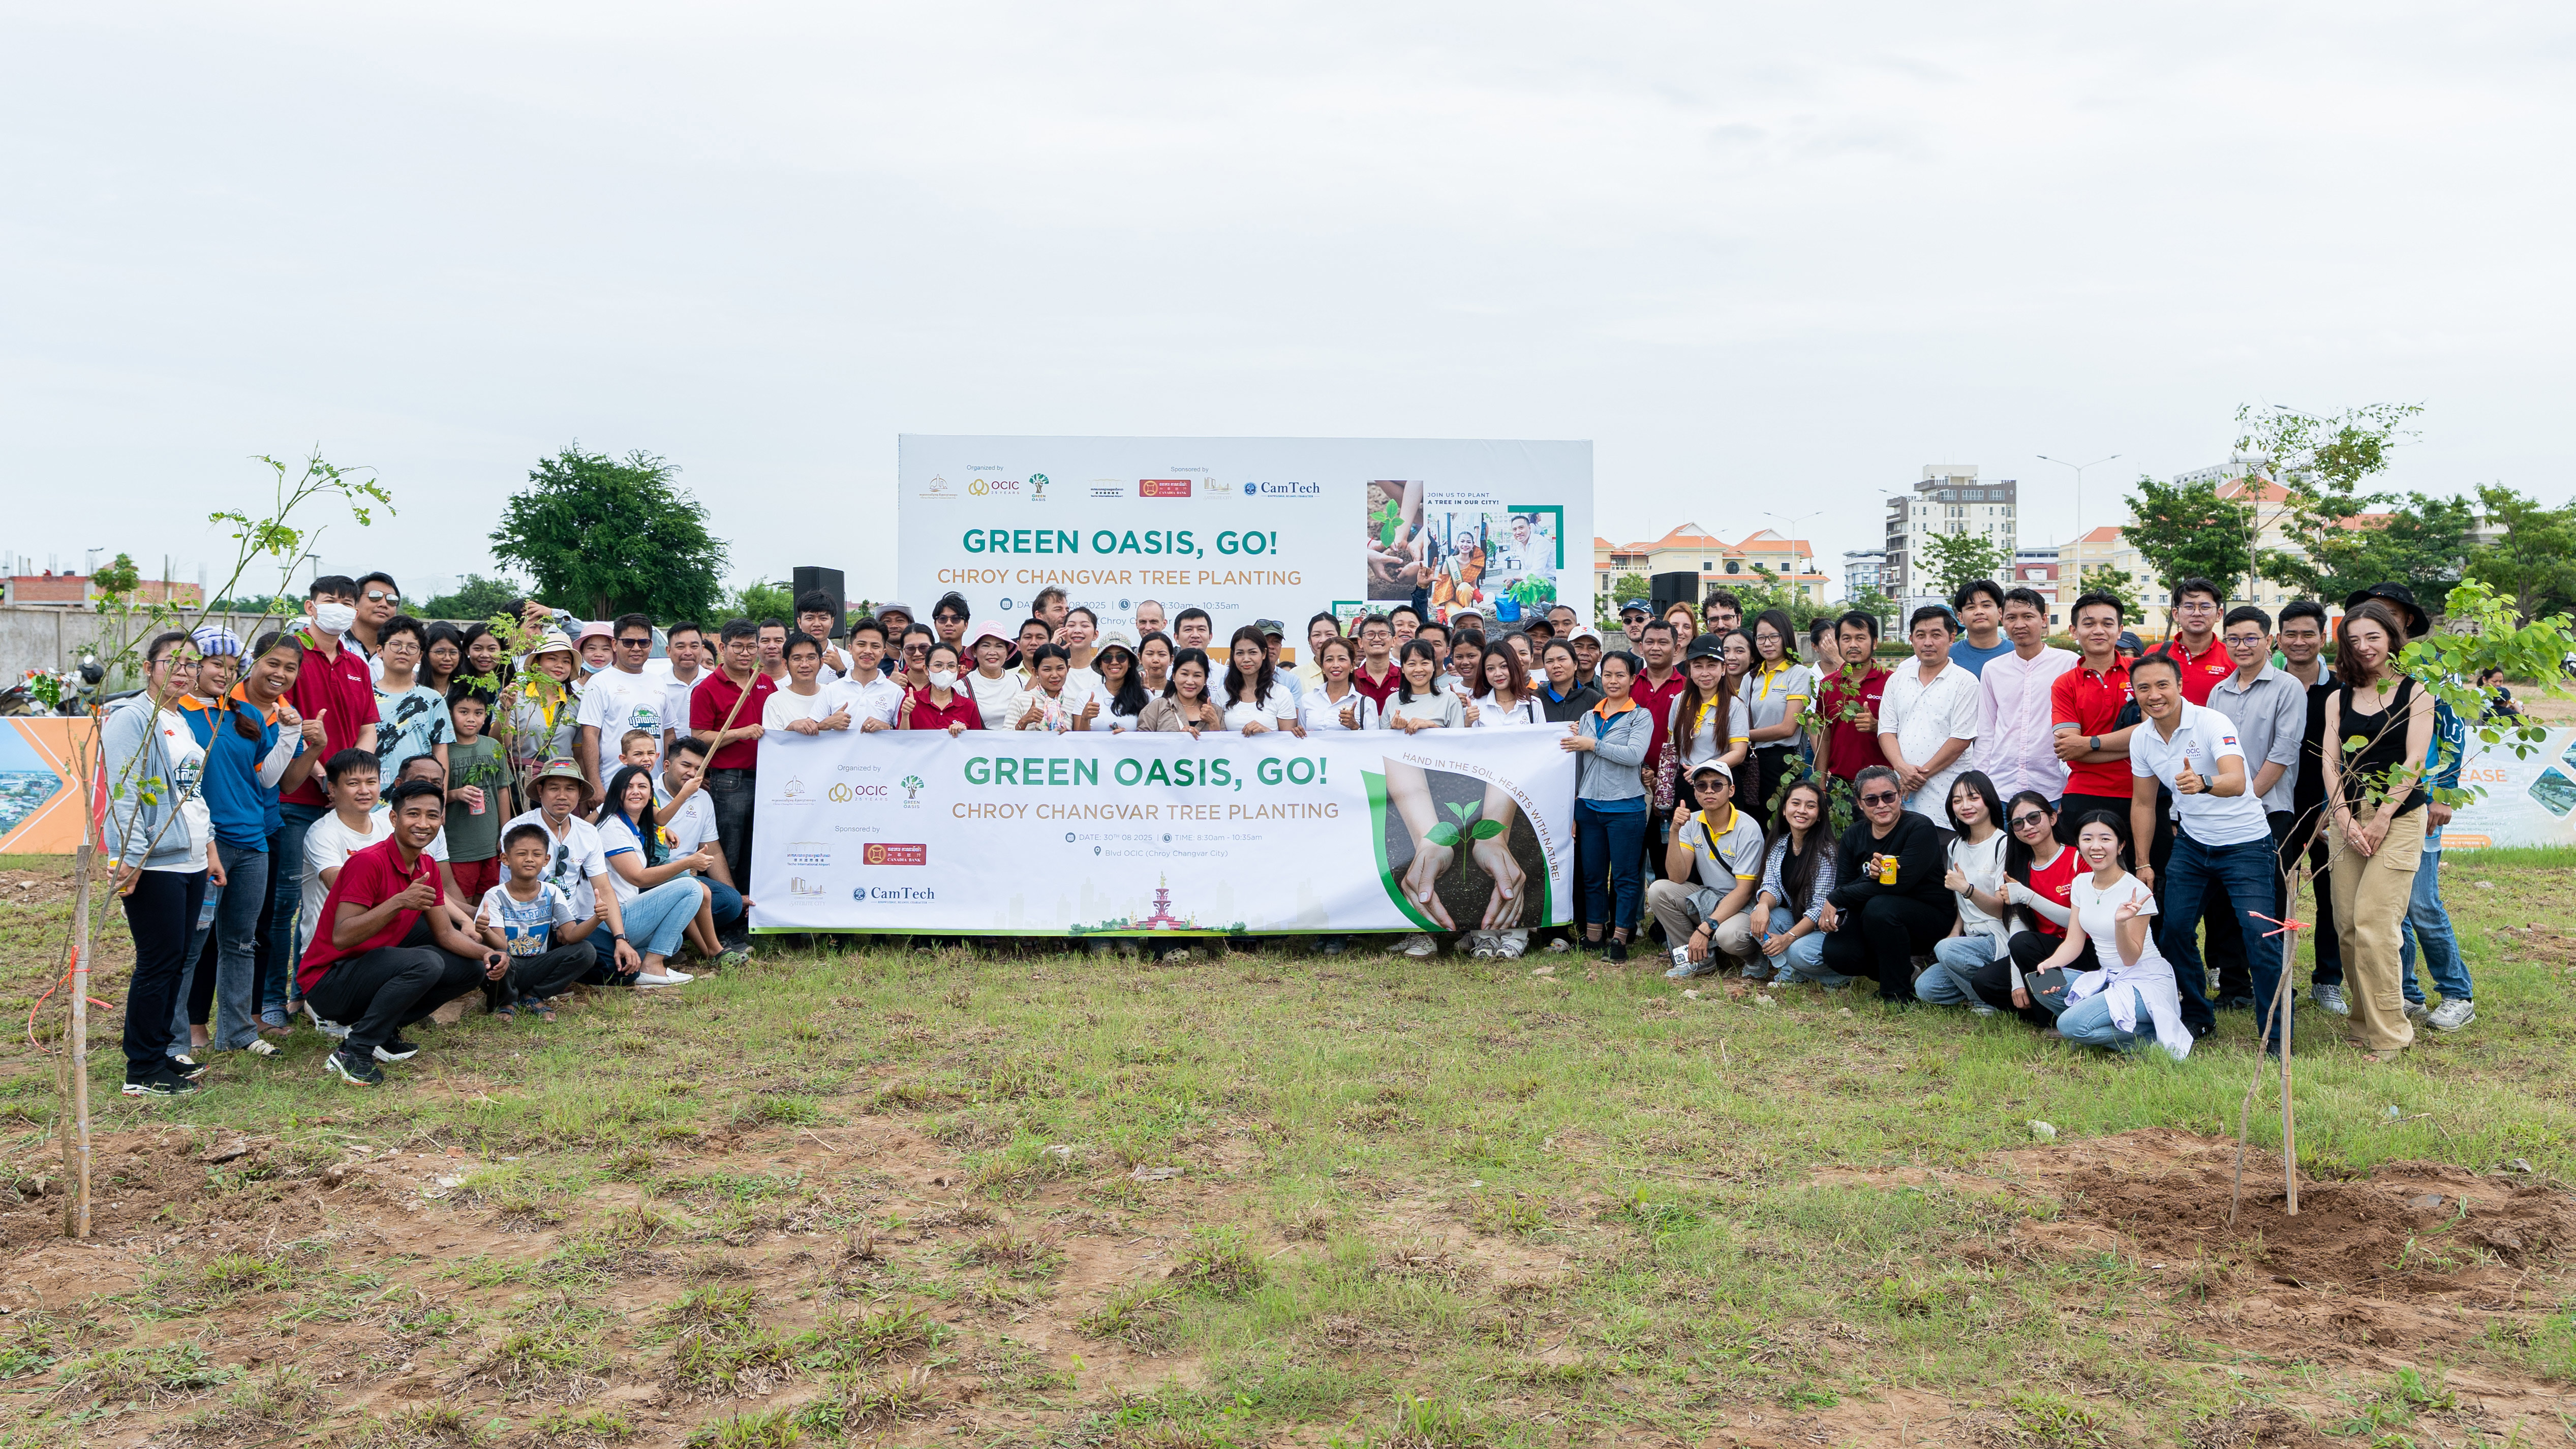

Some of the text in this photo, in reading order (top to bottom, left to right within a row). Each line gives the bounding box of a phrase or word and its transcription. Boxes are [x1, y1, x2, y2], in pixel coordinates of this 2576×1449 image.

[992, 481, 1019, 489] OCIC
[1261, 482, 1320, 493] CamTech
[963, 529, 1276, 559] GREEN OASIS, GO!
[938, 569, 1301, 585] CHROY CHANGVAR TREE PLANTING
[1097, 617, 1126, 626] (Chroy
[450, 755, 481, 768] FLEXING
[964, 757, 1327, 791] GREEN OASIS, GO!
[855, 786, 887, 795] OCIC
[953, 803, 1338, 820] CHROY CHANGVAR TREE PLANTING
[1402, 752, 1560, 882] HAND IN THE SOIL, HEARTS WITH NATURE!
[871, 887, 934, 899] CamTech
